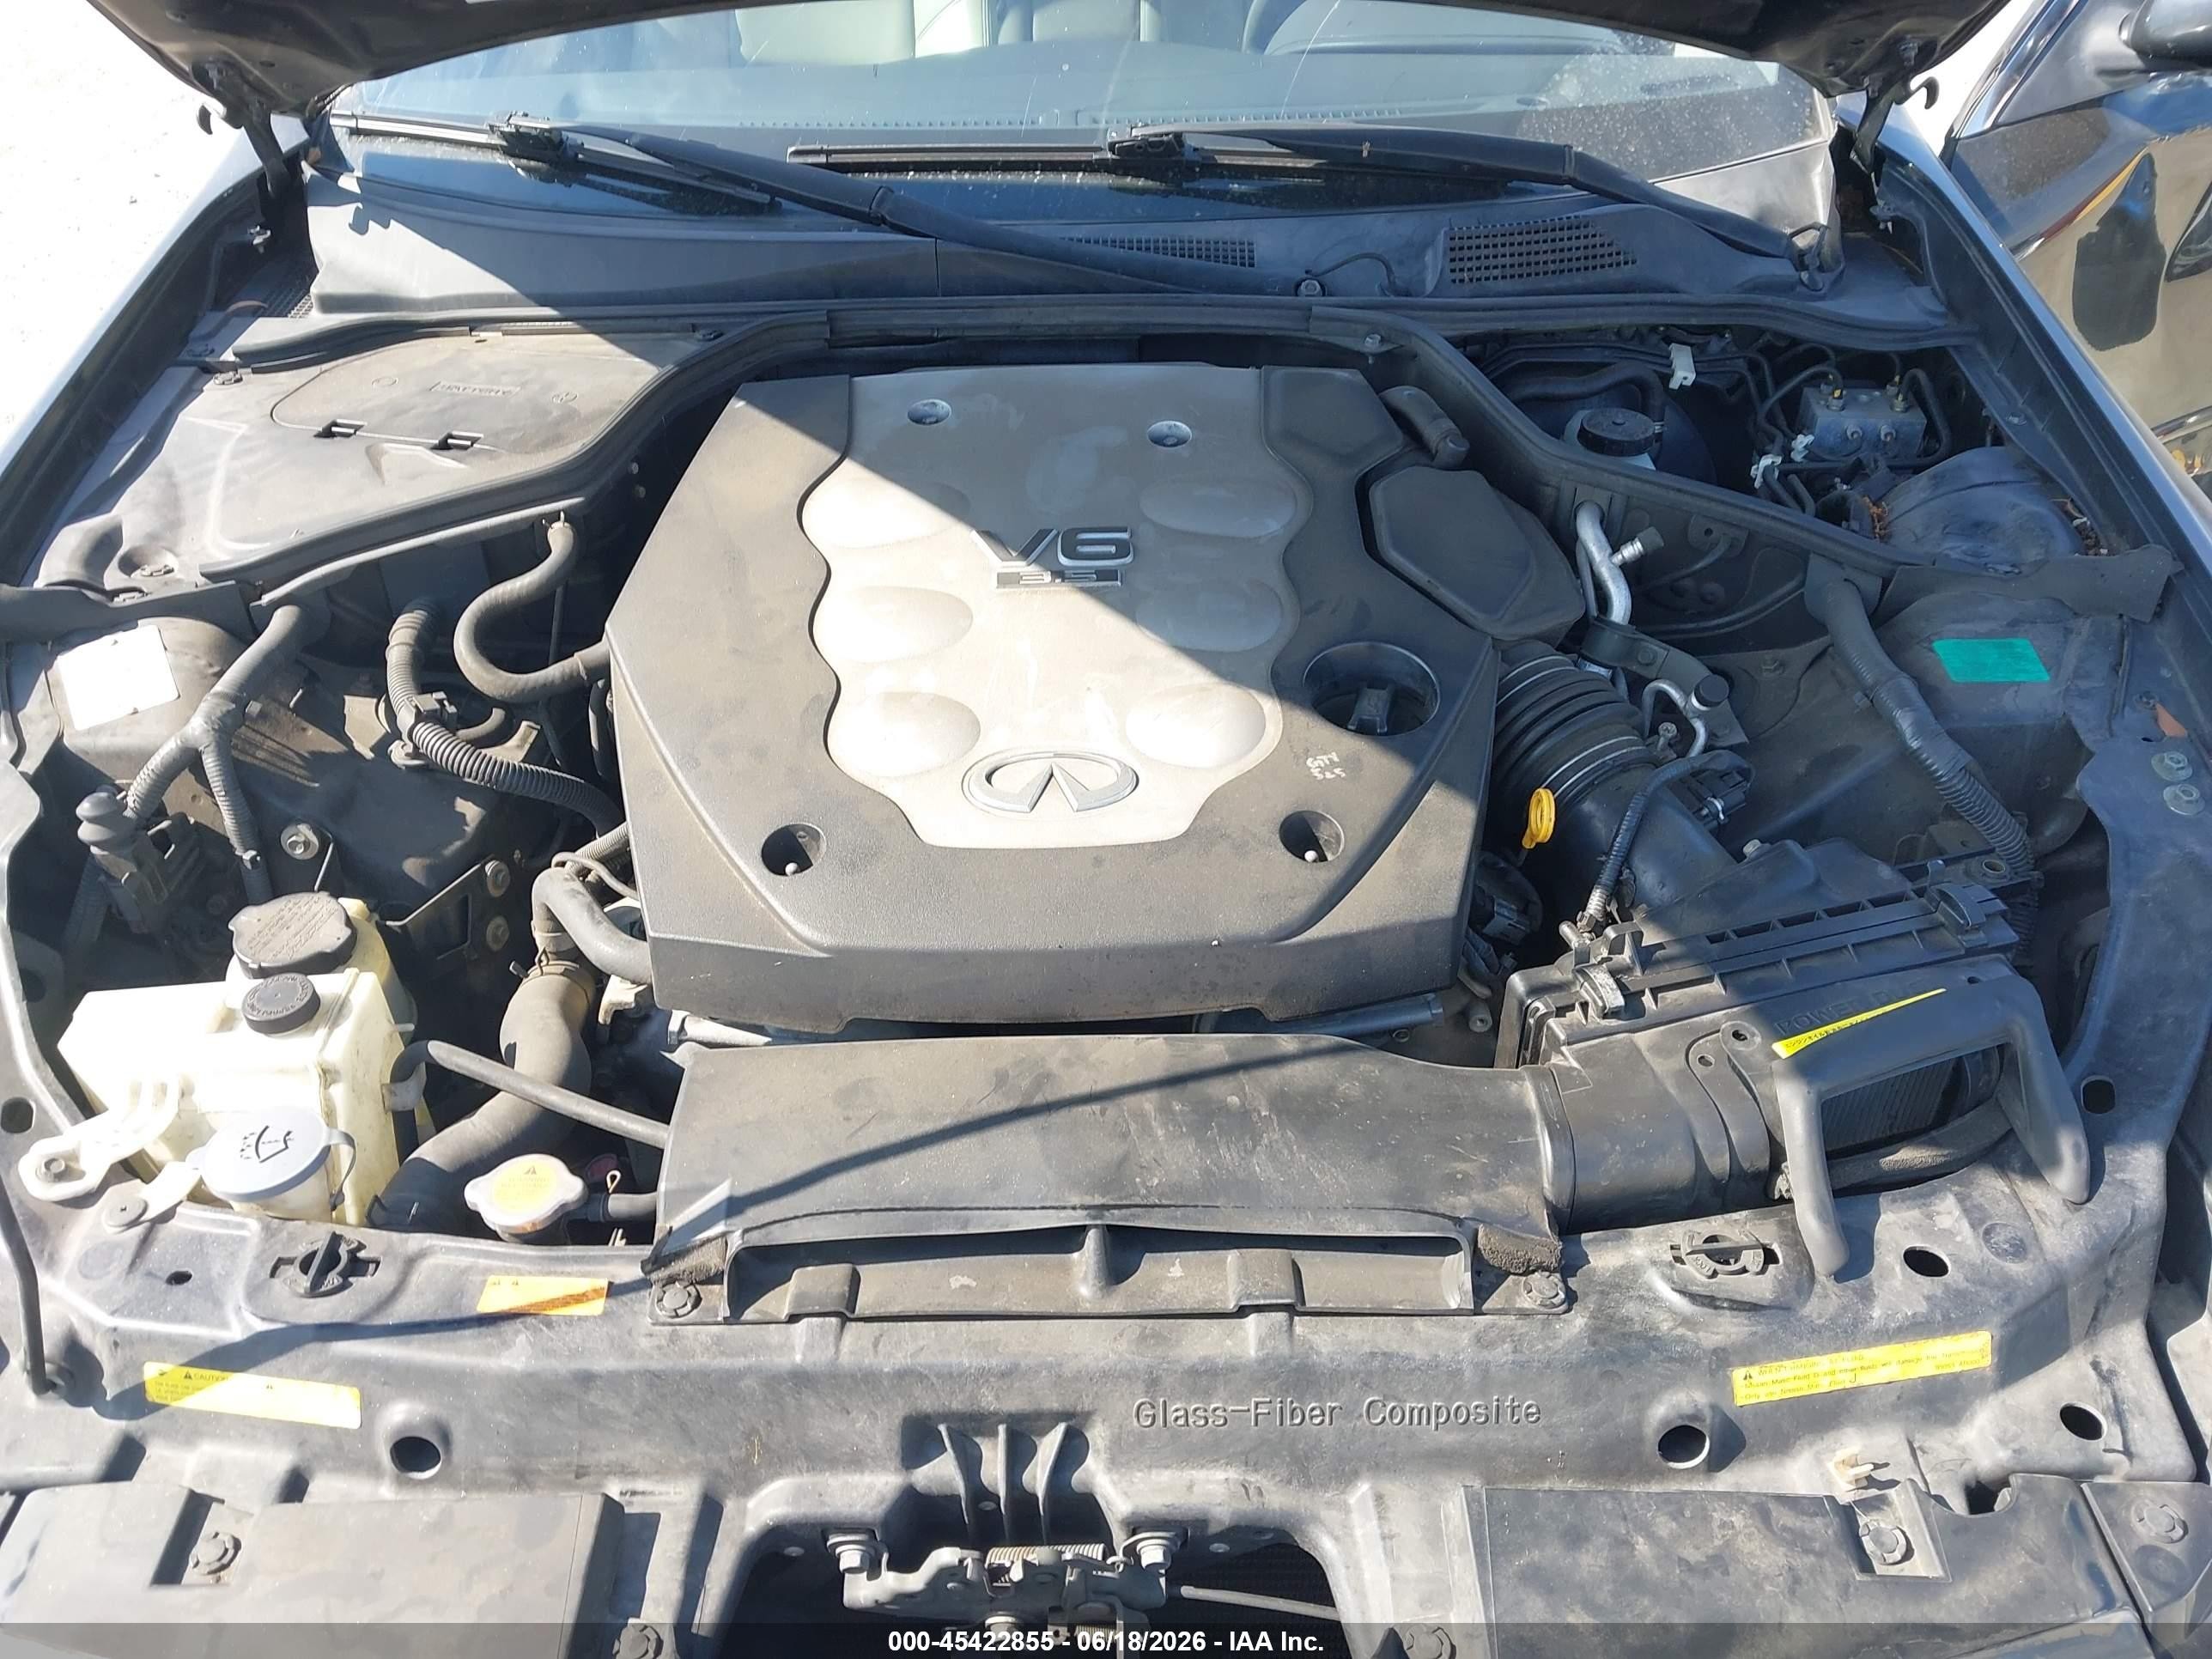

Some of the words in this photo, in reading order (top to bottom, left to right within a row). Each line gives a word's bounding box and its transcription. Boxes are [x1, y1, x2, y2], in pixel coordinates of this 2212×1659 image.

[970, 526, 1134, 568] V6
[194, 1372, 230, 1382] CAUTIO
[1133, 1397, 1343, 1429] Glass-Fiber
[1363, 1395, 1542, 1431] Composite
